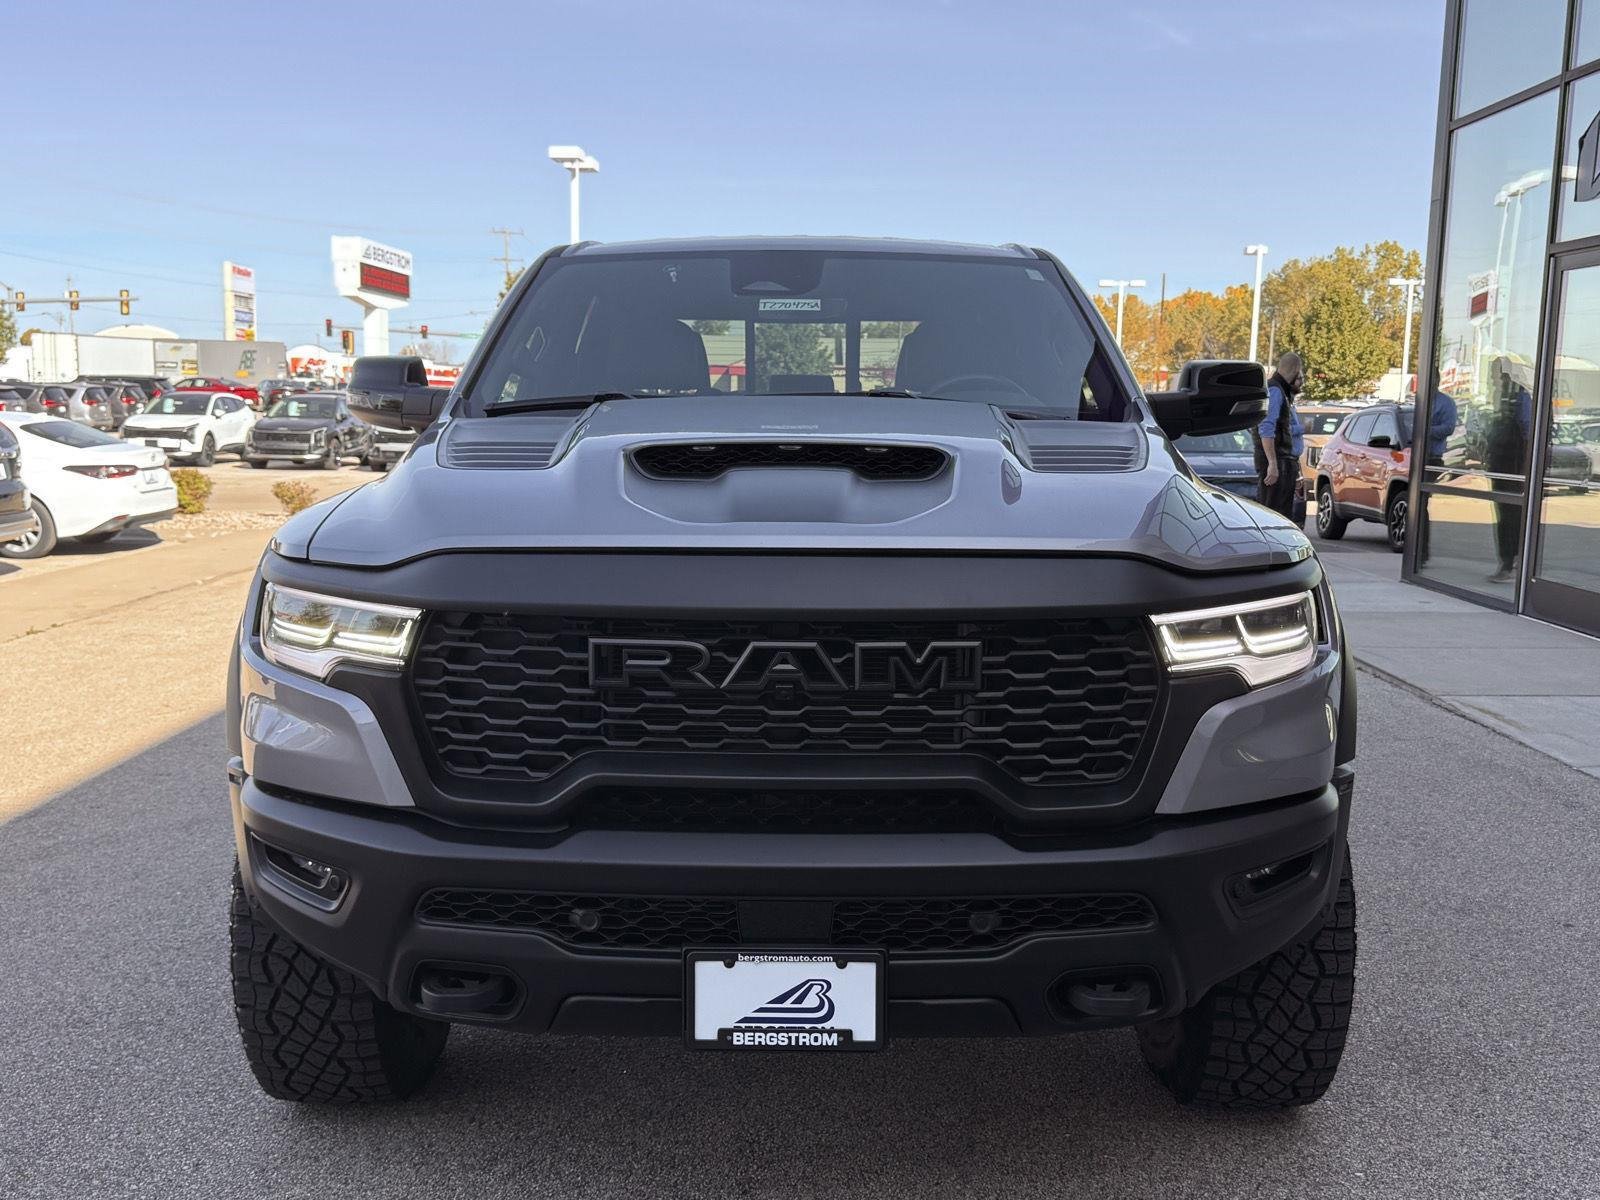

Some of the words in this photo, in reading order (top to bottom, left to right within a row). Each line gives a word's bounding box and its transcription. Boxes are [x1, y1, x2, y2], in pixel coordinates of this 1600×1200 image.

[588, 637, 982, 689] RAM
[737, 953, 834, 964] bergstromauto.com
[732, 1032, 838, 1046] BERGSTROM
